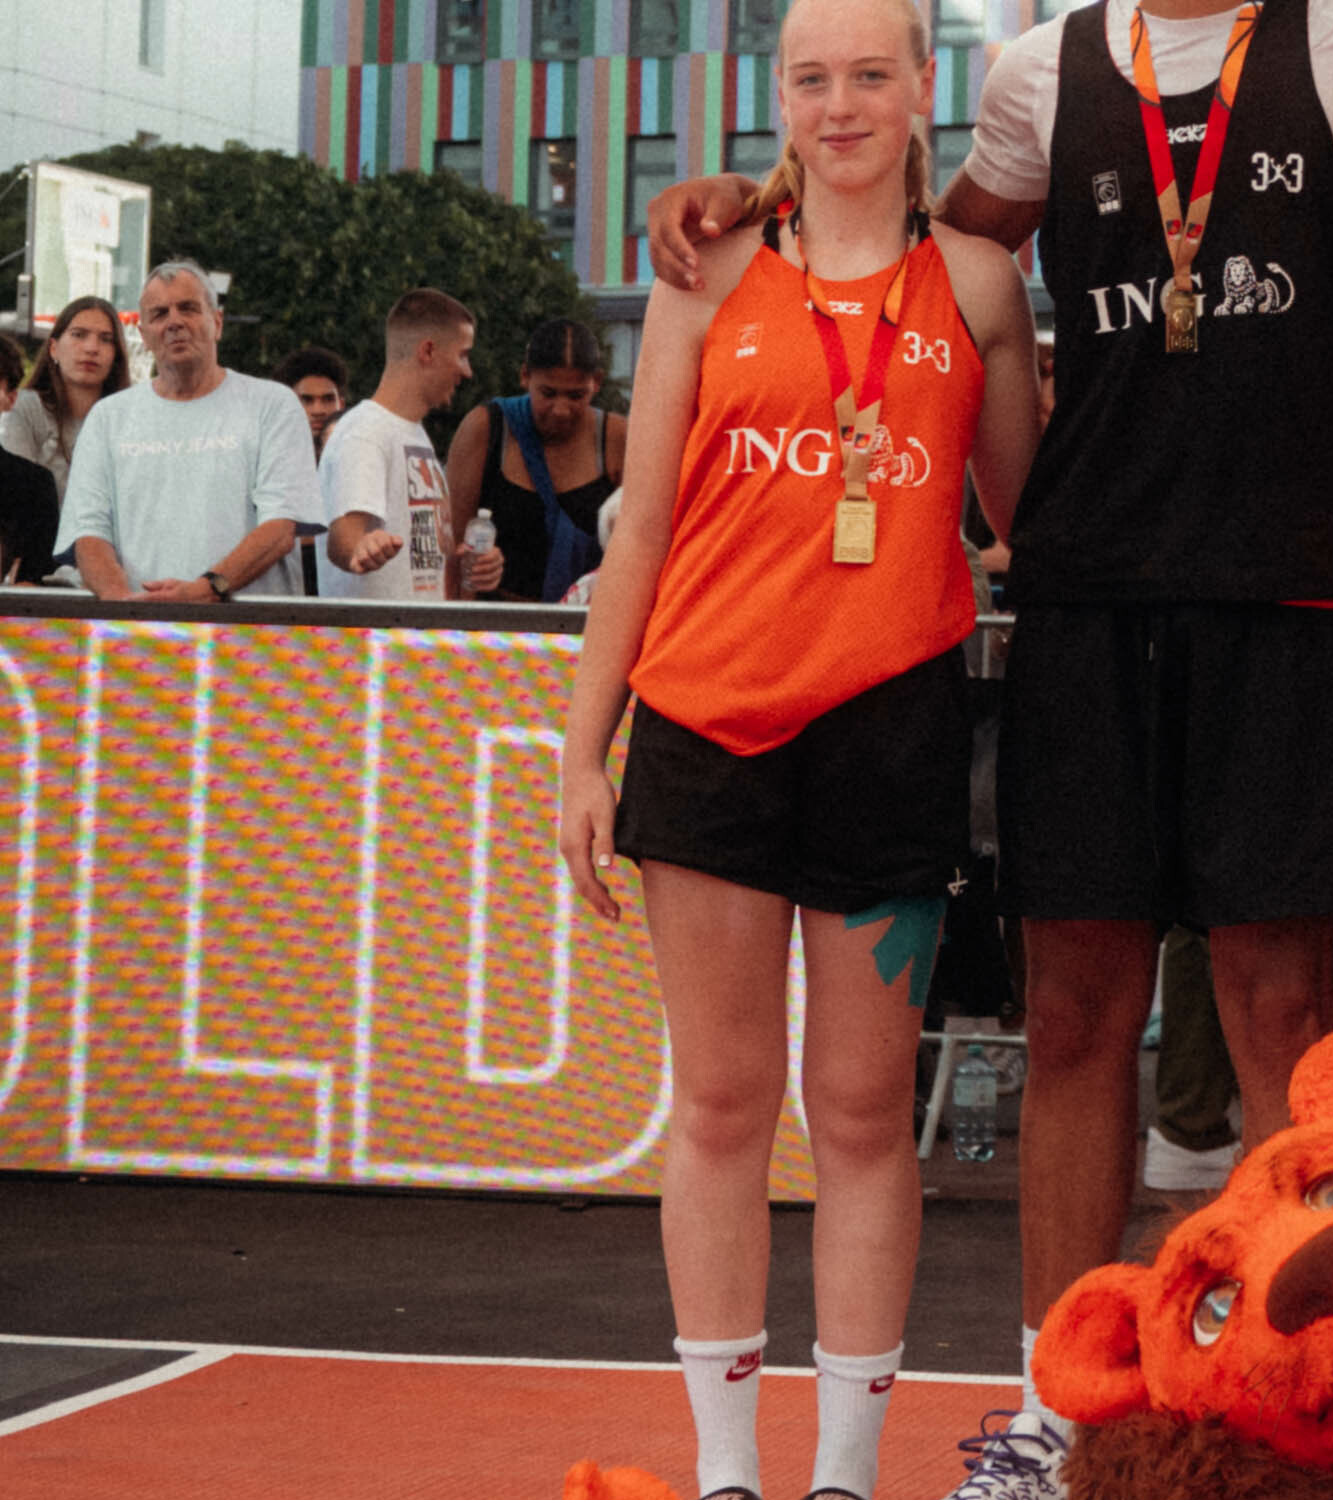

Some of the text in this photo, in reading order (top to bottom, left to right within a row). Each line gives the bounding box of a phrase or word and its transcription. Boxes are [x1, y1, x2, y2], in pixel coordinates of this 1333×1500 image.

[119, 435, 239, 457] TOMMY JEANS
[723, 427, 834, 476] ING
